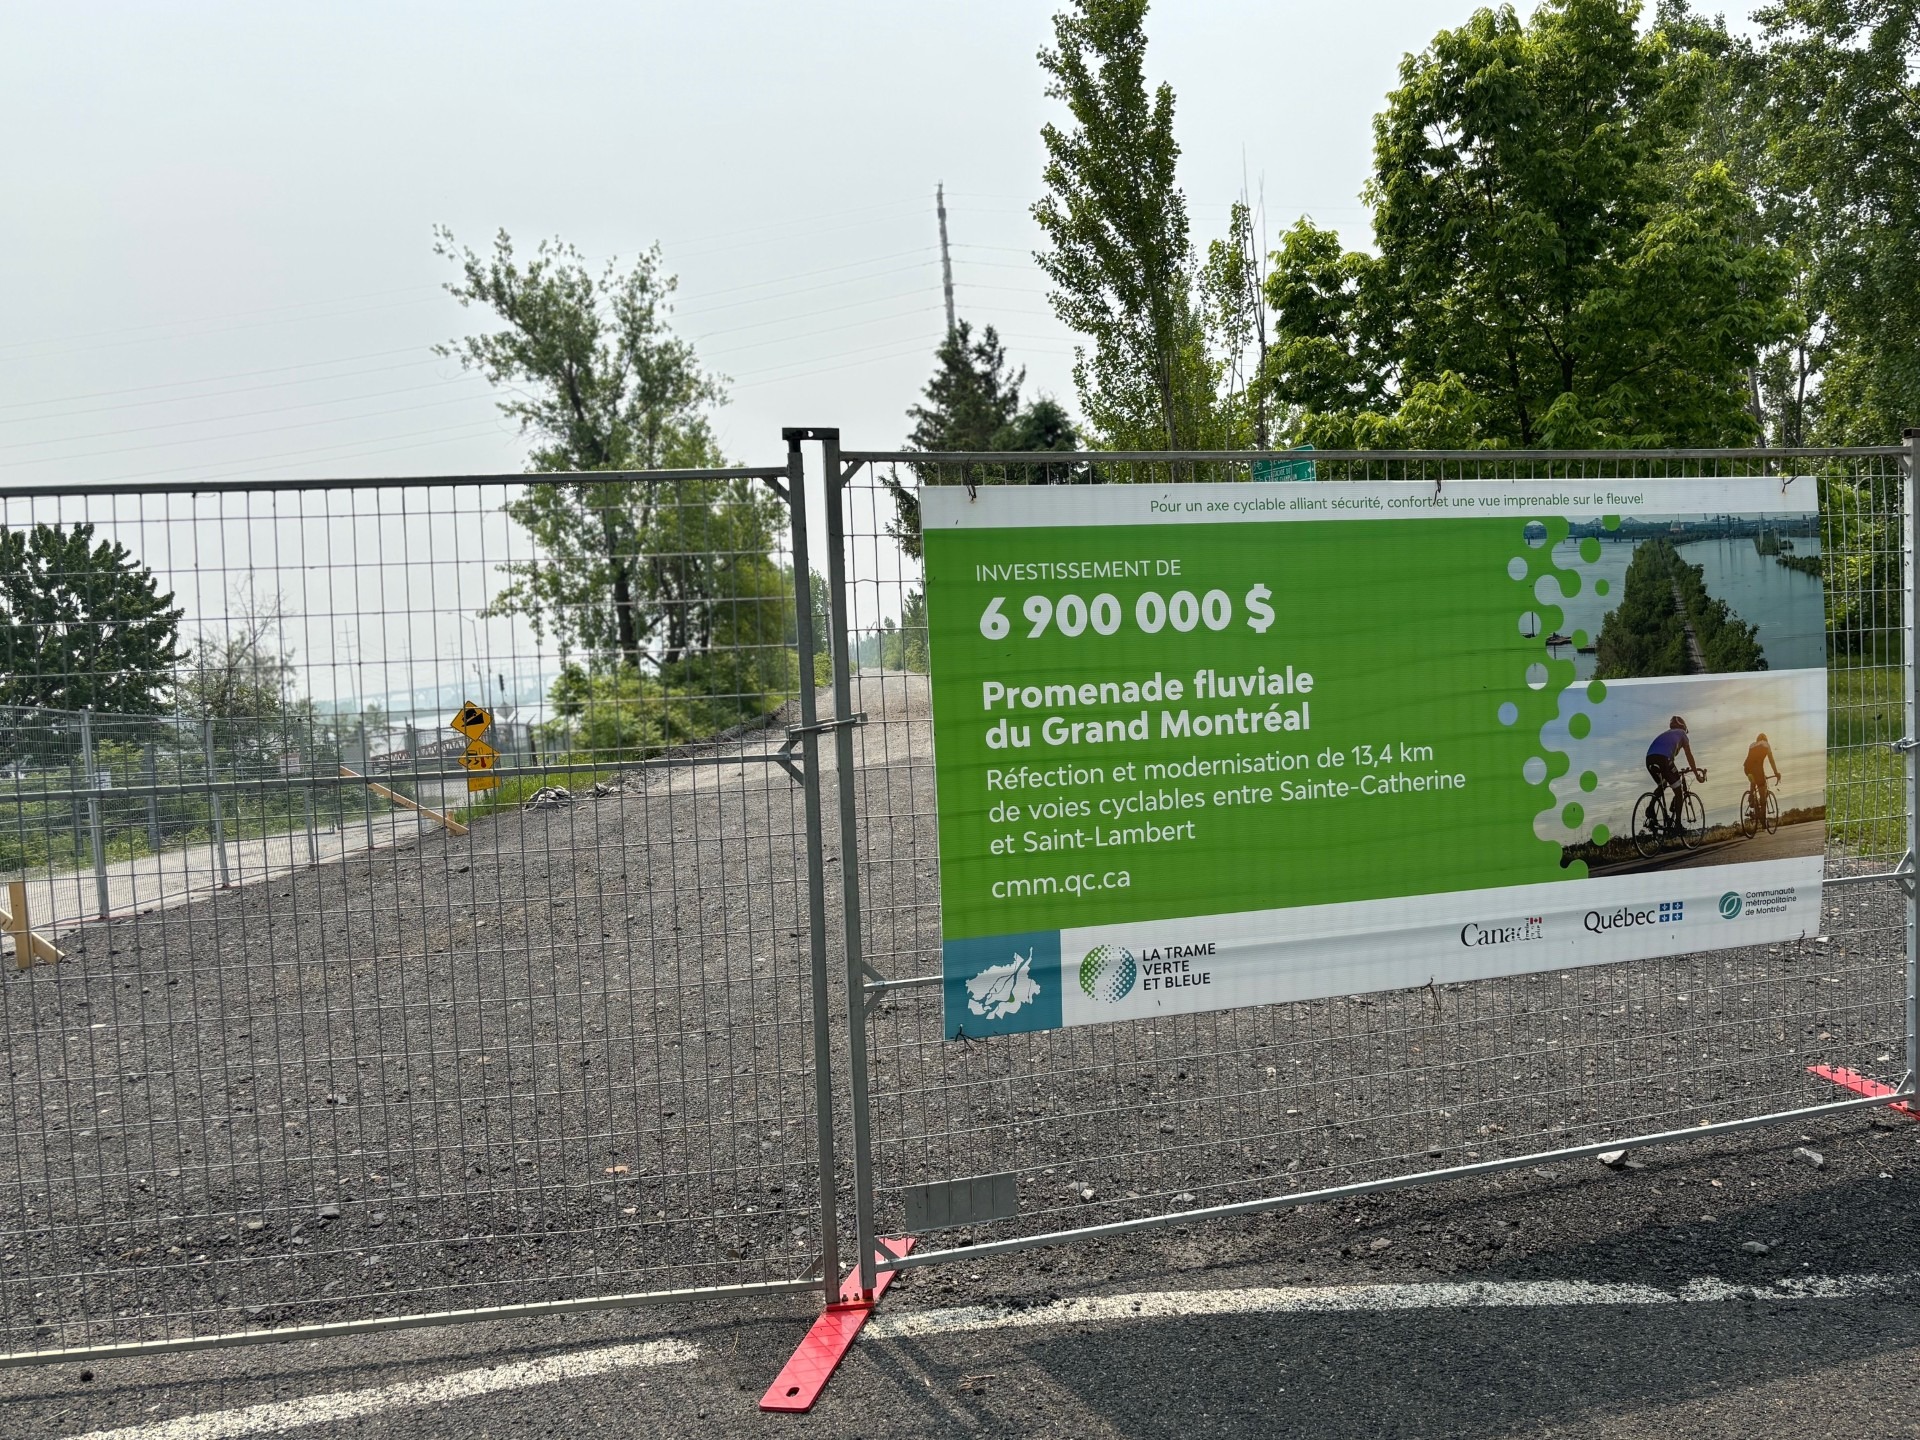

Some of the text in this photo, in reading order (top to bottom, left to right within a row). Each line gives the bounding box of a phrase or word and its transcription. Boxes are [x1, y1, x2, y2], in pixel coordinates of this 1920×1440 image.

[1151, 501, 1181, 512] Pour
[1186, 503, 1202, 511] un
[1207, 502, 1229, 511] axe
[1234, 498, 1285, 513] cyclable
[1290, 498, 1327, 509] alliant
[1332, 496, 1383, 510] sécurité,
[1388, 496, 1432, 507] confort
[1437, 497, 1448, 507] et
[1453, 498, 1474, 506] une
[1478, 498, 1500, 506] vue
[1504, 494, 1569, 508] imprenable
[1594, 493, 1603, 504] le
[1607, 493, 1643, 504] fleuve!
[977, 560, 1181, 581] INVESTISSEMENT DE
[980, 584, 1275, 640] 6 900 000 $
[983, 666, 1313, 710] Promenade fluviale
[986, 702, 1309, 749] du Grand Montréal
[987, 742, 1432, 790] Réfection et modernisation de 13,4 km
[989, 770, 1466, 822] de voies cyclables entre Sainte-Catherine
[991, 821, 1195, 854] et Saint-Lambert
[992, 871, 1130, 898] cmm.qc.ca
[1745, 887, 1795, 899] Communauté
[1745, 896, 1797, 908] métropolitaine
[1745, 905, 1786, 916] de Montréal
[1584, 907, 1655, 933] Québec
[1143, 943, 1215, 962] LA TRAME
[1142, 960, 1190, 976] VERTE
[1144, 972, 1211, 990] ET BLEUE
